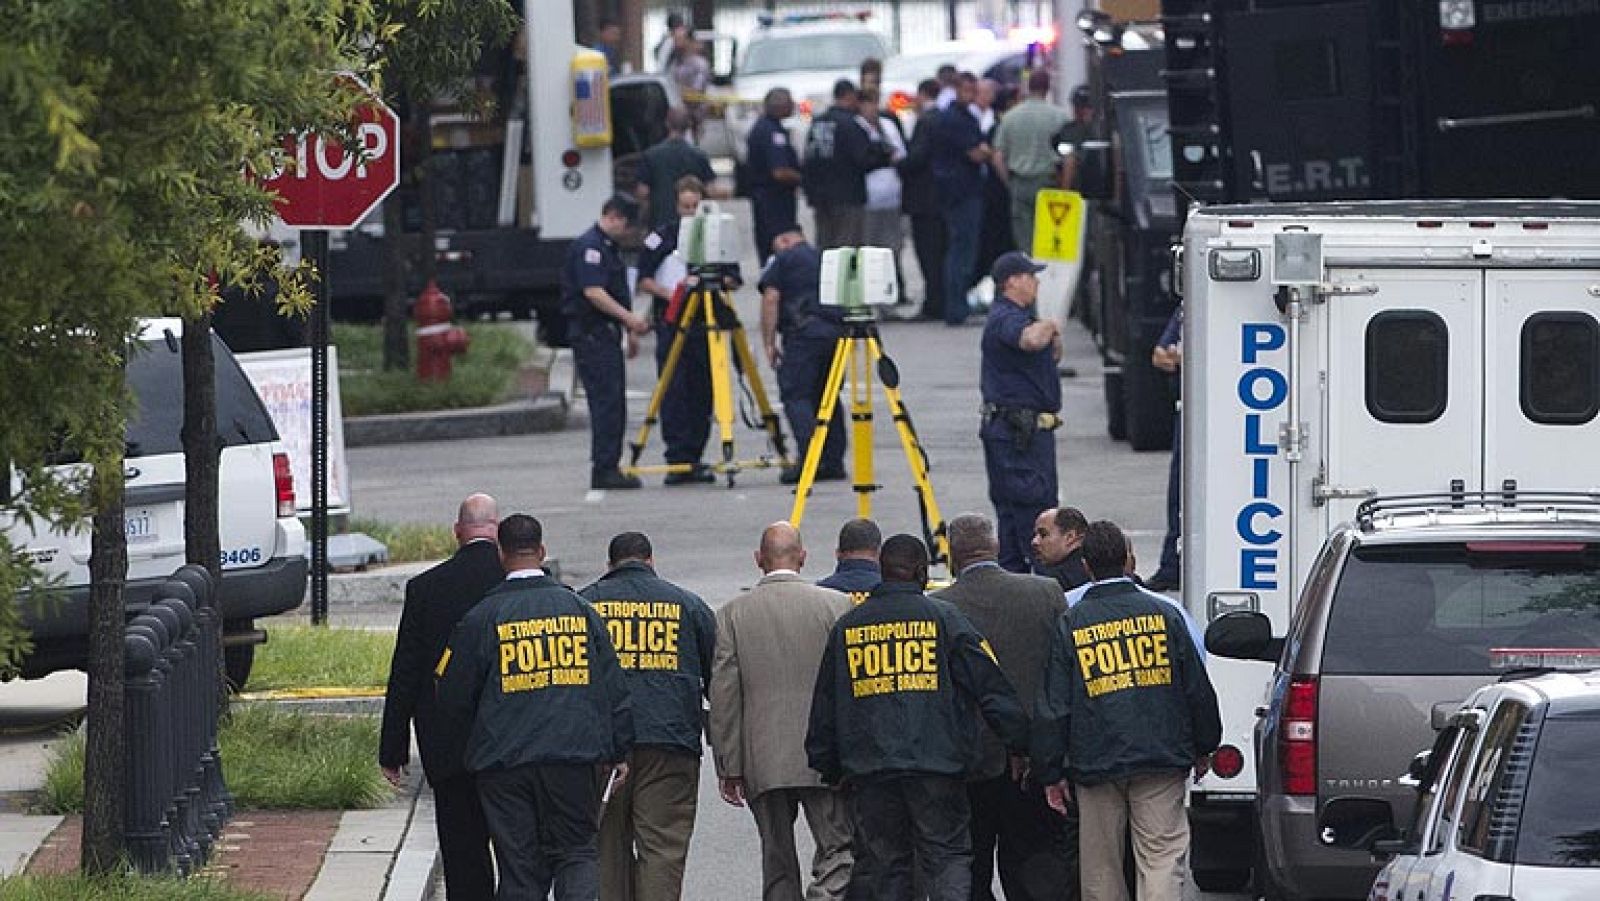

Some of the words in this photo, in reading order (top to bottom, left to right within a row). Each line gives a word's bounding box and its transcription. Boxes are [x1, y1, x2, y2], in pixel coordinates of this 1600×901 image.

[1236, 322, 1288, 590] POLICE
[497, 616, 587, 641] METROPOLITAN
[606, 618, 679, 652] OLICE
[845, 621, 937, 645] METROPOLITAN
[1072, 614, 1165, 647] METROPOLITAN
[501, 635, 588, 675] POLICE
[847, 640, 938, 679] POLICE
[1078, 634, 1170, 681] POLICE
